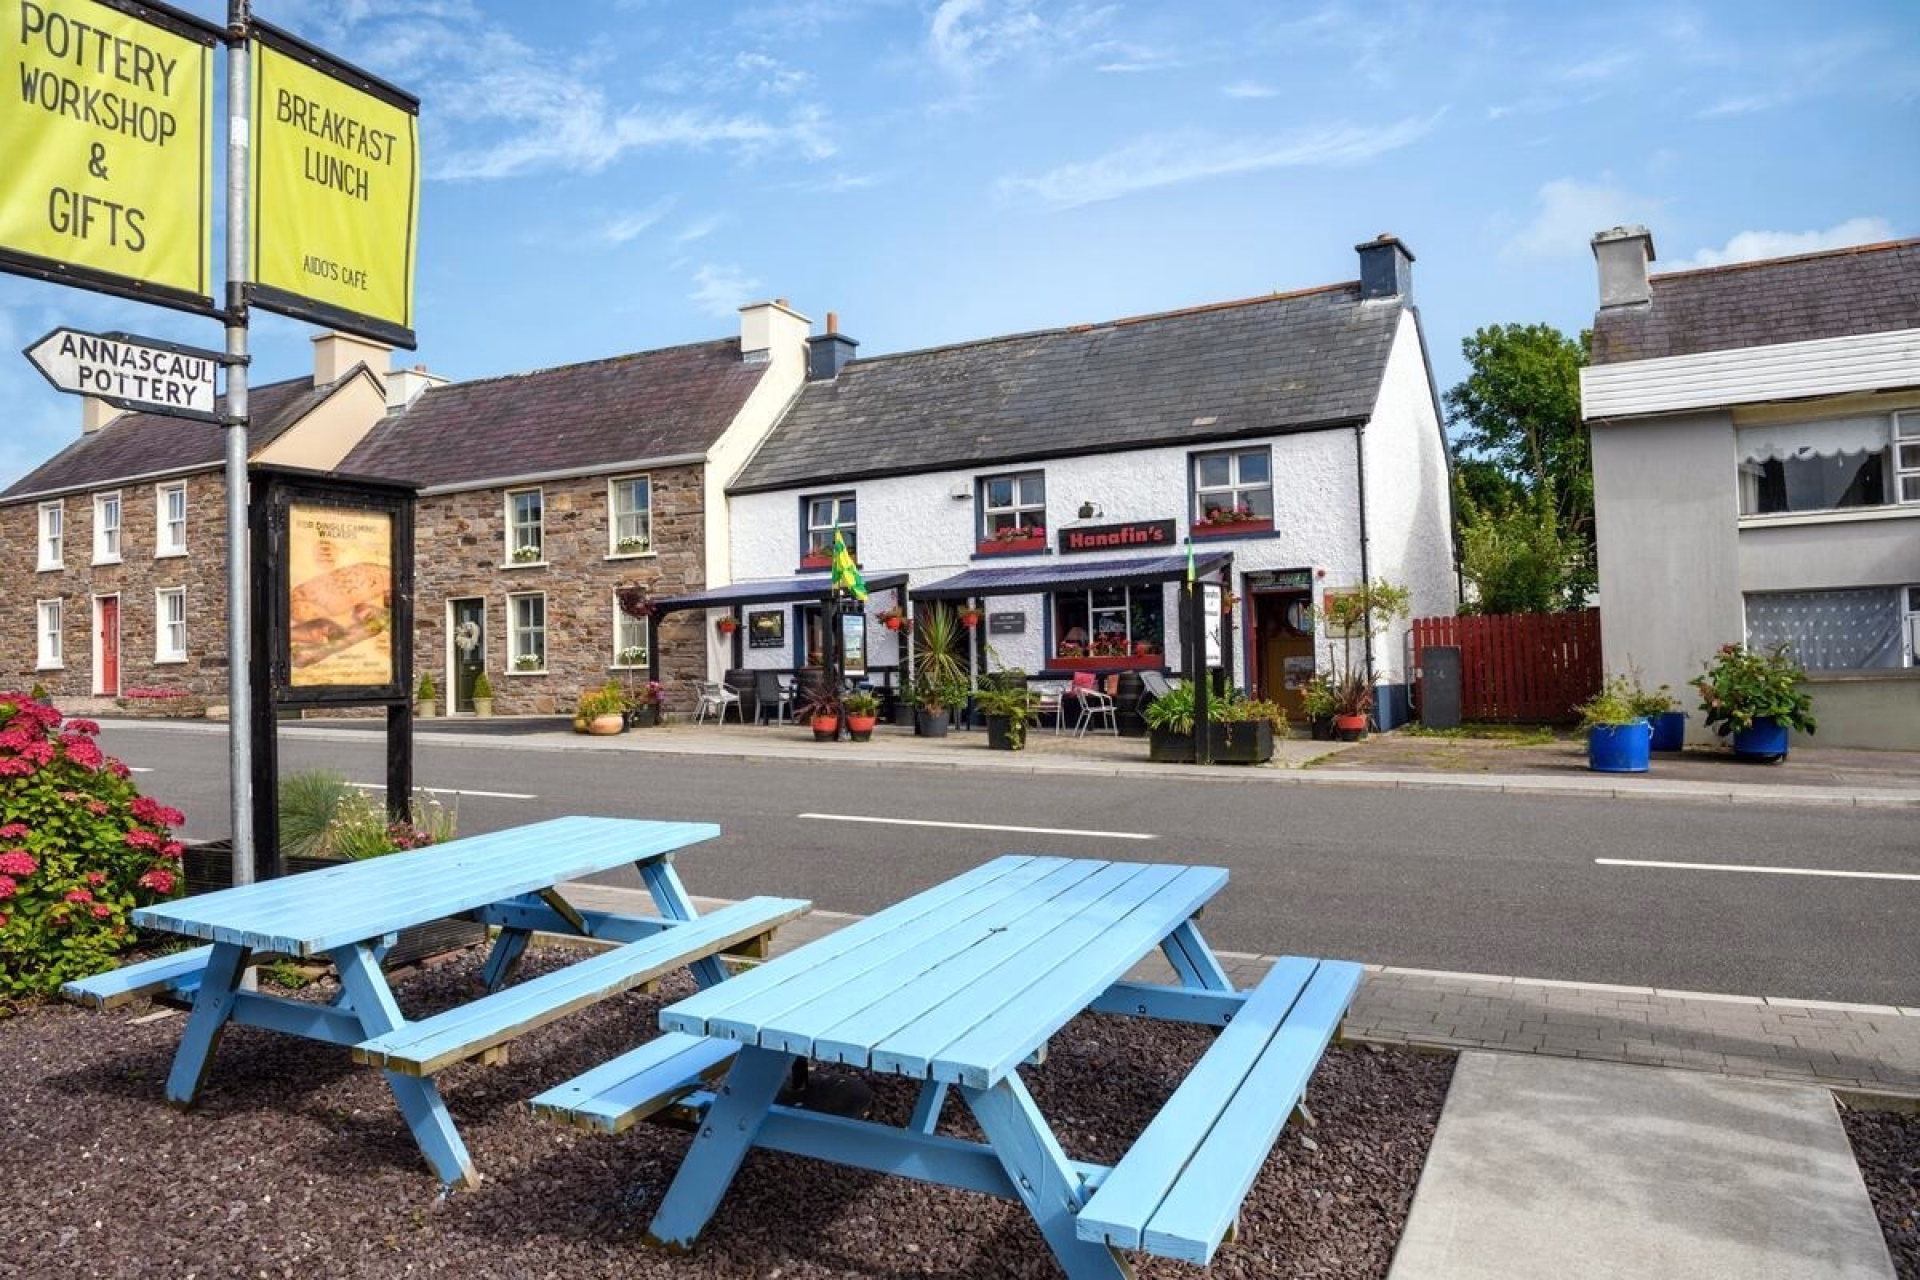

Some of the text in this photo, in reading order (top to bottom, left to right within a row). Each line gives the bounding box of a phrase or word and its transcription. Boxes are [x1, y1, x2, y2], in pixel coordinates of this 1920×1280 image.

[20, 1, 177, 96] POTTERY
[20, 61, 177, 147] WORKSHOP
[276, 88, 397, 166] BREAKFAST
[88, 142, 109, 180] &
[305, 146, 369, 202] LUNCH
[49, 187, 145, 252] GIFTS
[60, 334, 212, 384] ANNASCAUL
[79, 365, 197, 406] POTTERY
[1069, 526, 1164, 548] Hanafin's
